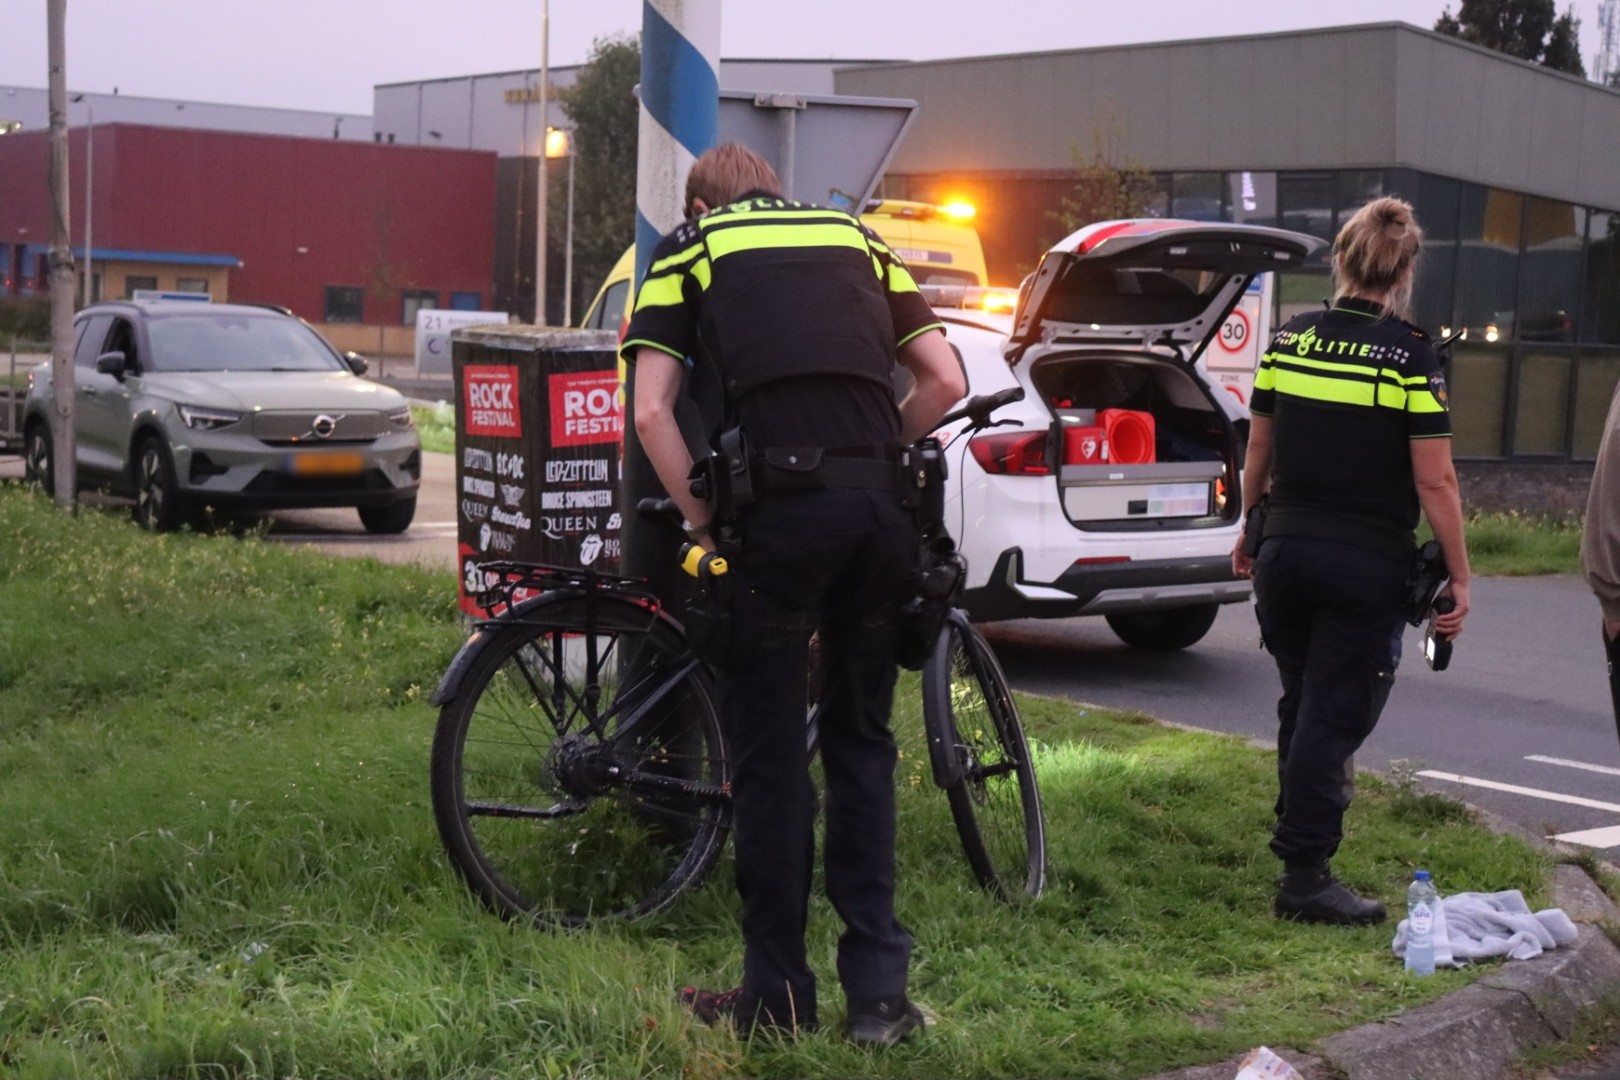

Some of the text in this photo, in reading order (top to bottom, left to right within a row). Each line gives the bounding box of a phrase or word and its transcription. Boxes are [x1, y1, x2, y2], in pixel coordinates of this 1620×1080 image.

[425, 316, 442, 330] 21
[1223, 323, 1245, 340] 30
[1288, 325, 1372, 357] POLITIE
[469, 382, 514, 409] ROCK
[472, 410, 516, 427] FESTIVAL
[462, 498, 488, 522] QUEEN
[540, 516, 597, 539] QUEEN
